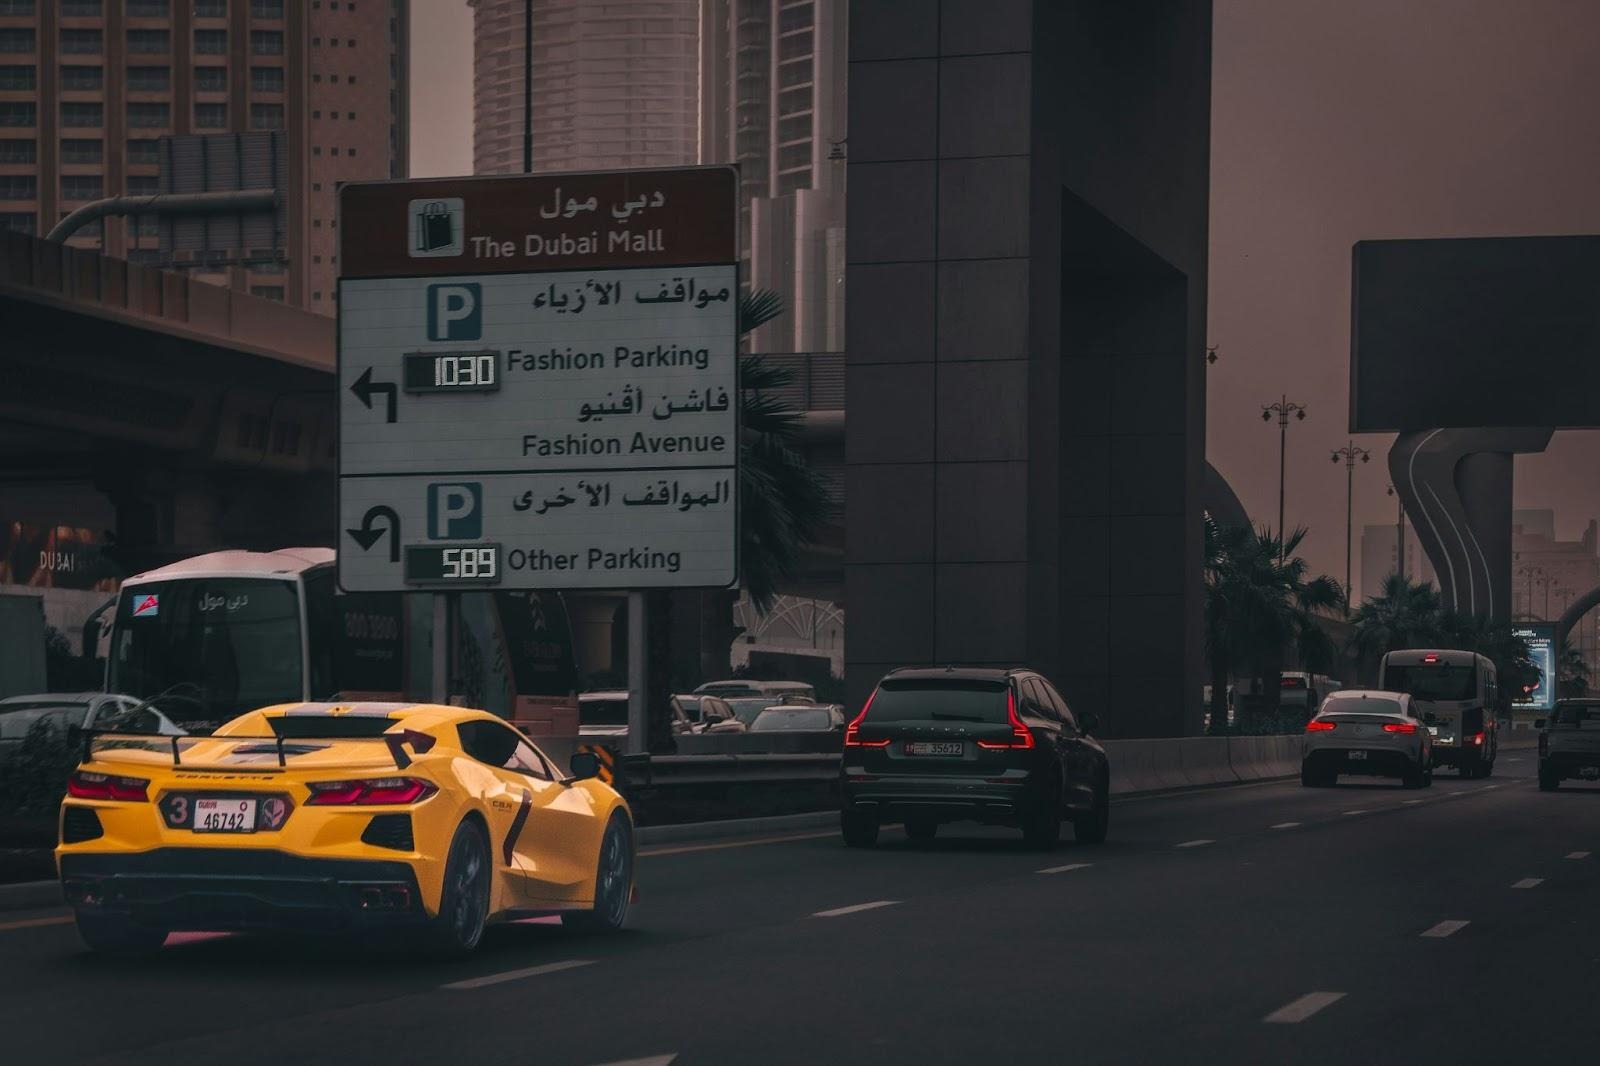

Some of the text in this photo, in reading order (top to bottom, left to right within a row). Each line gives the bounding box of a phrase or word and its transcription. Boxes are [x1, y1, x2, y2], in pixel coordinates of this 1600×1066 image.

[539, 187, 666, 223] دبي مول
[470, 229, 665, 258] The Dubai Mall
[532, 277, 730, 314] مواقف الأزياء
[436, 286, 476, 339] P
[434, 355, 495, 387] 1030
[507, 344, 709, 372] Fashion Parking
[652, 386, 729, 420] فاشن
[522, 431, 725, 457] Fashion Avenue
[622, 479, 730, 512] المواقف
[437, 485, 475, 537] P
[39, 550, 75, 573] DUBAI
[442, 548, 496, 578] 589
[508, 546, 681, 573] Other Parking
[169, 796, 189, 825] 3
[203, 812, 245, 830] 46742
